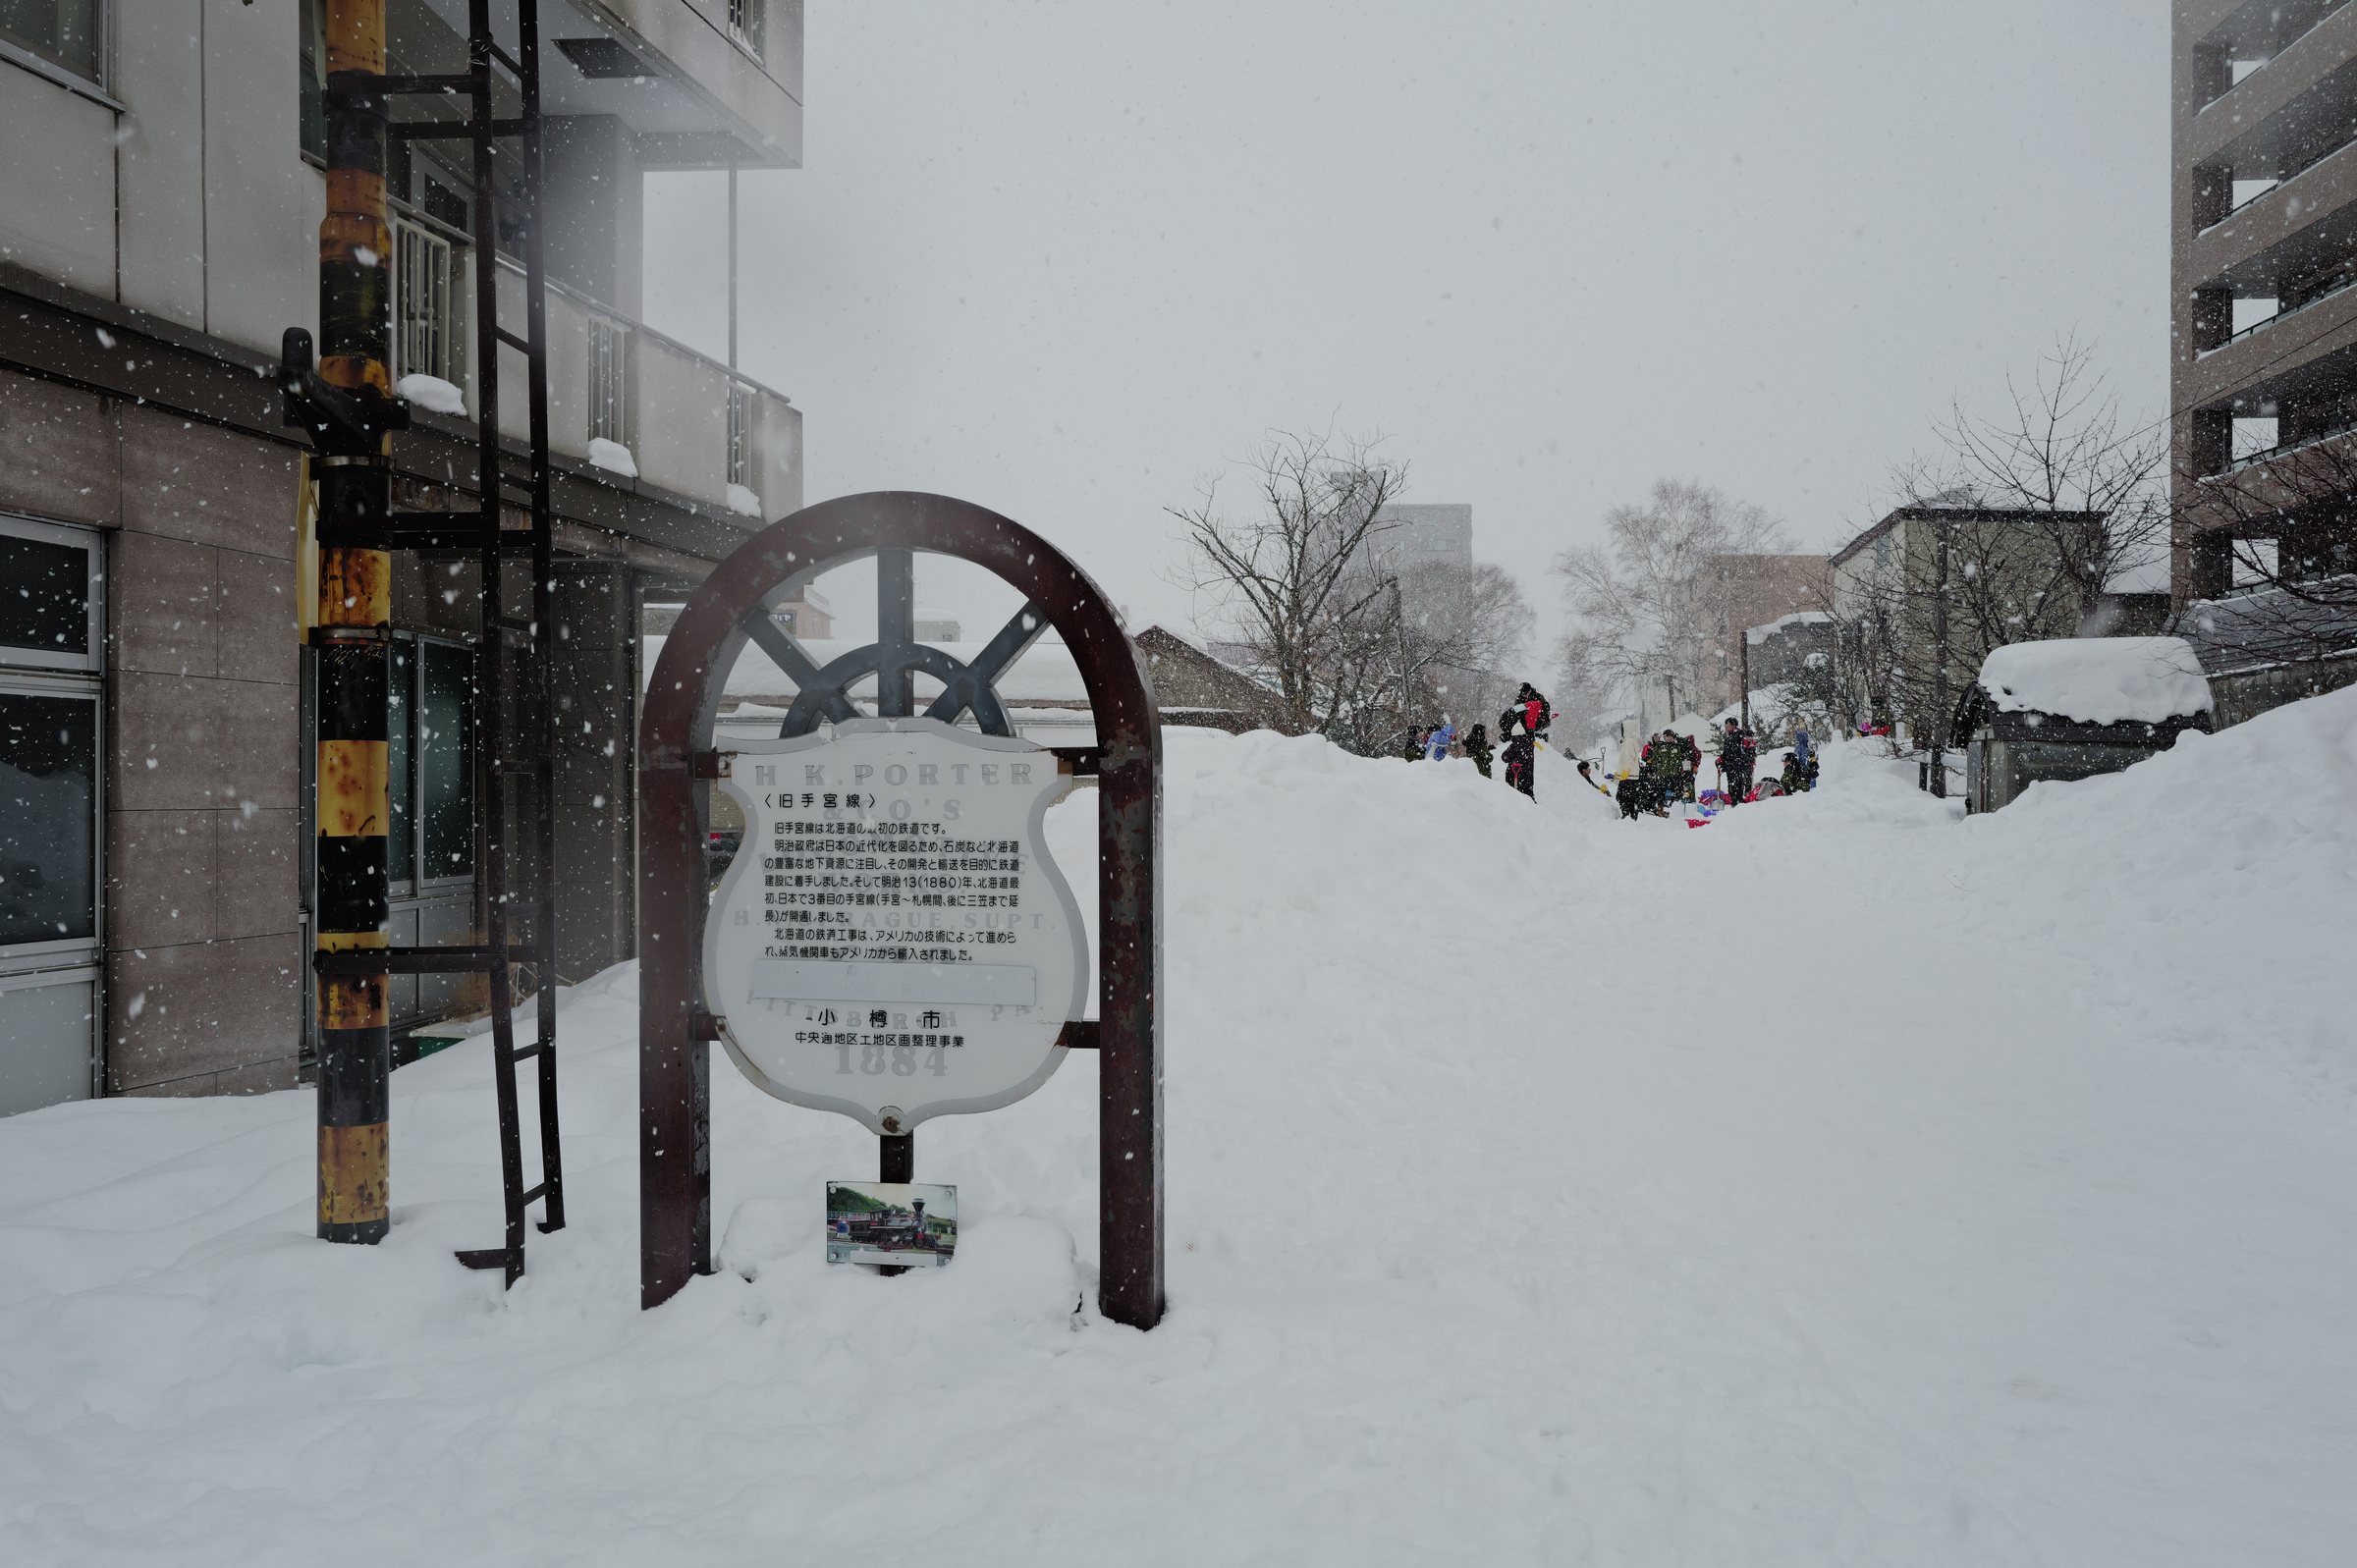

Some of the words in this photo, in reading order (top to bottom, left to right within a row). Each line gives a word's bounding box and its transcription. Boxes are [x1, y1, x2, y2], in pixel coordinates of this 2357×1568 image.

[774, 839, 1019, 853] 明治政府は日本の近代化を図るため、石炭など北海道
[764, 857, 1019, 871] の豊富な地下資源に注目し、その開発と輸送を目的に鉄道
[764, 910, 850, 923] 長)が開通しました。
[774, 928, 1016, 944] 北海道の鉄道工事は、アメリカの技術によって進めら
[764, 946, 973, 961] れ、蒸気機関車もアメリカから輸入されました。
[834, 1044, 949, 1077] 1884
